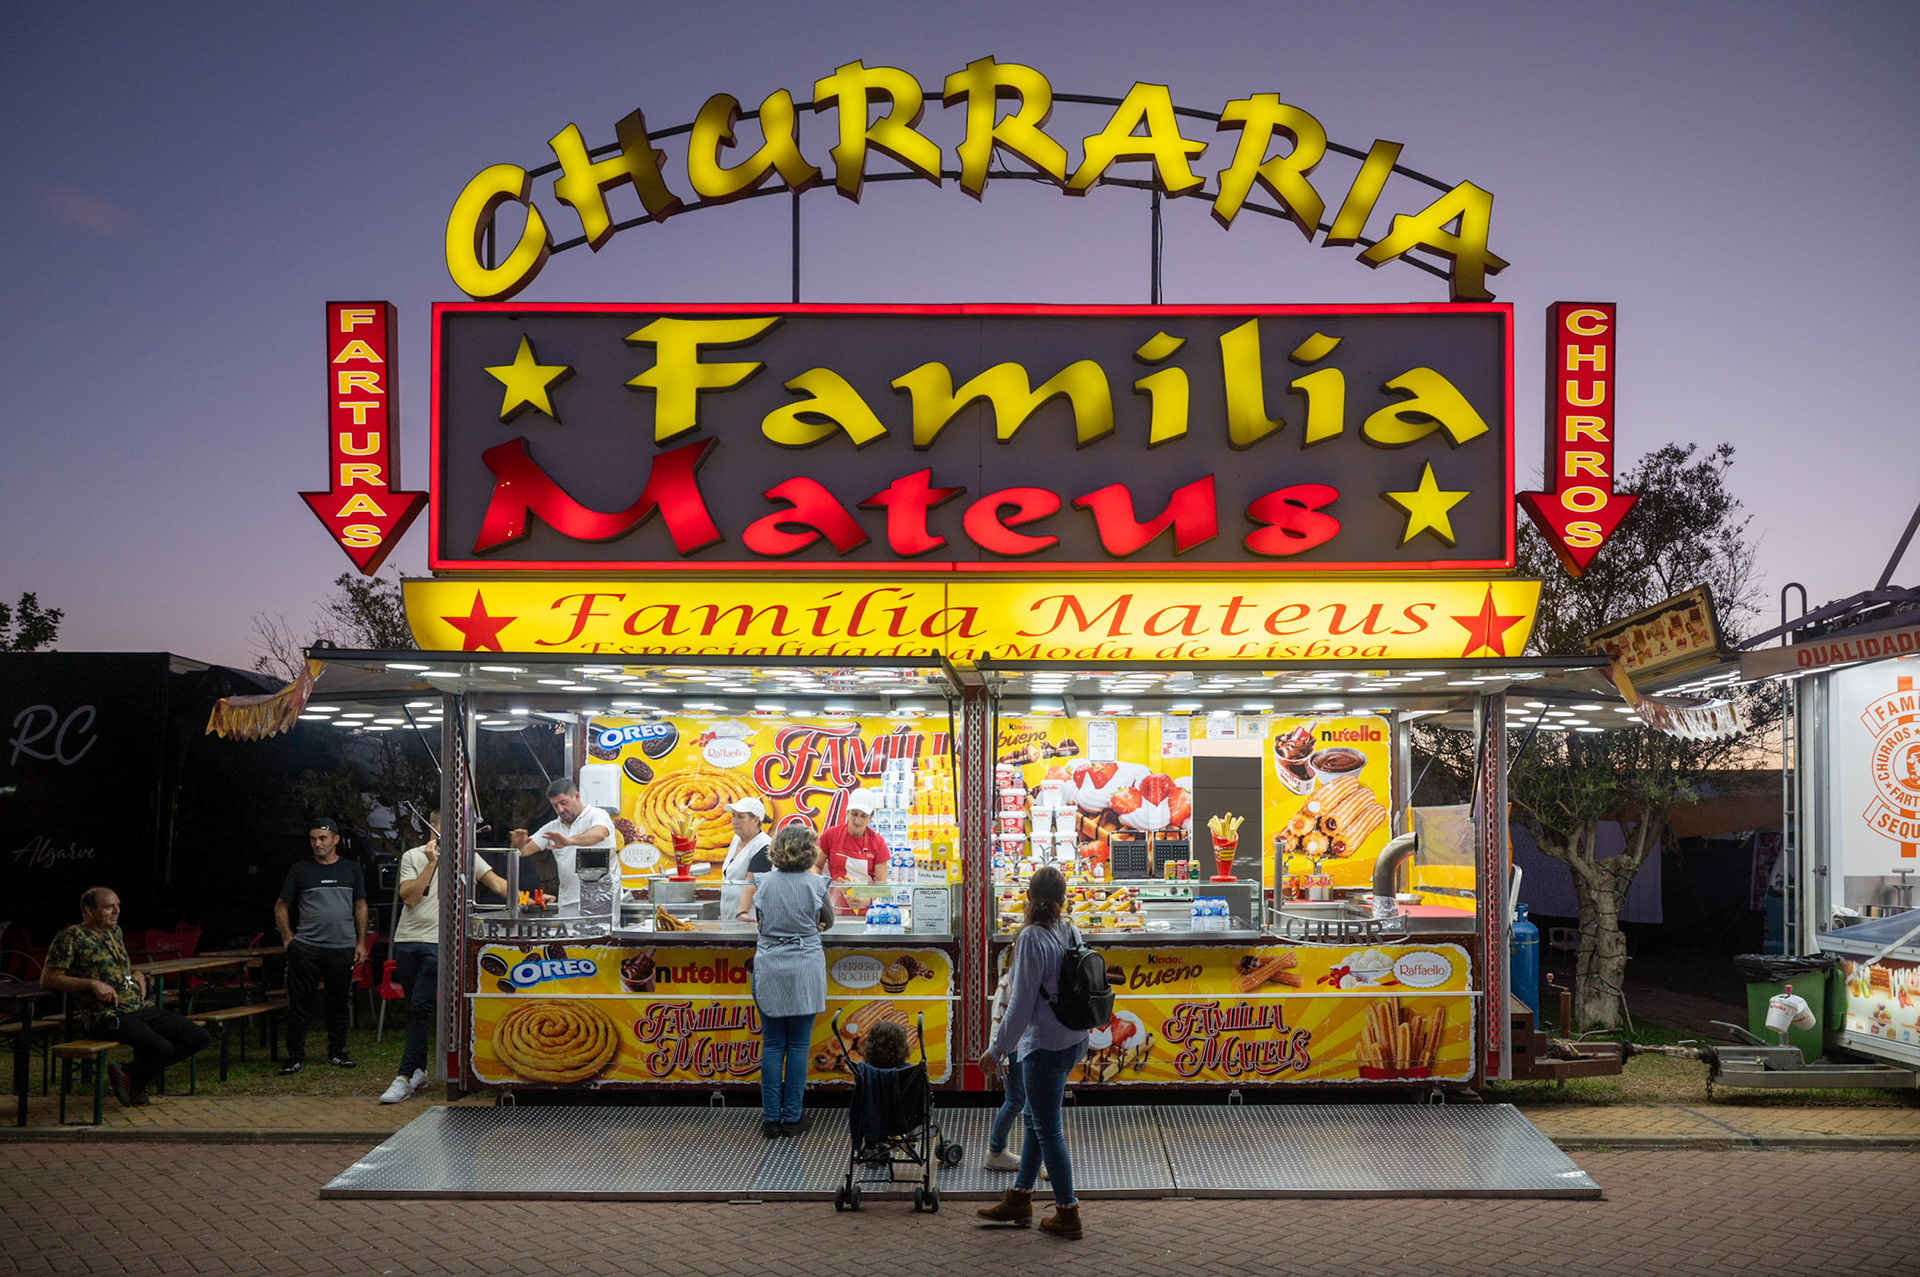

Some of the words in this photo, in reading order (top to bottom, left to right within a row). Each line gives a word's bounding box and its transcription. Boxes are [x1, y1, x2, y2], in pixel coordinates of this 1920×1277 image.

[445, 55, 1510, 302] CHURRARIA
[333, 308, 388, 549] FARTURAS
[1560, 308, 1609, 549] CHURROS
[471, 436, 1342, 557] Mateus
[1015, 593, 1437, 638] Mateus
[991, 640, 1137, 660] Moda
[1155, 640, 1209, 659] de
[1228, 639, 1392, 659] Lisboa
[9, 704, 98, 767] RC
[600, 724, 668, 748] OREO
[997, 731, 1047, 748] bueno
[1321, 725, 1381, 741] nutella
[708, 748, 747, 758] Raffaello
[1876, 727, 1911, 781] CHURROS
[12, 835, 97, 868] Algarve
[513, 959, 595, 984] OREO
[655, 958, 747, 983] nutella
[838, 962, 880, 971] FERRERO
[838, 971, 879, 980] ROCHER
[1130, 965, 1202, 990] bueno
[1400, 964, 1445, 977] Raffaello
[645, 1036, 762, 1076] MATEU
